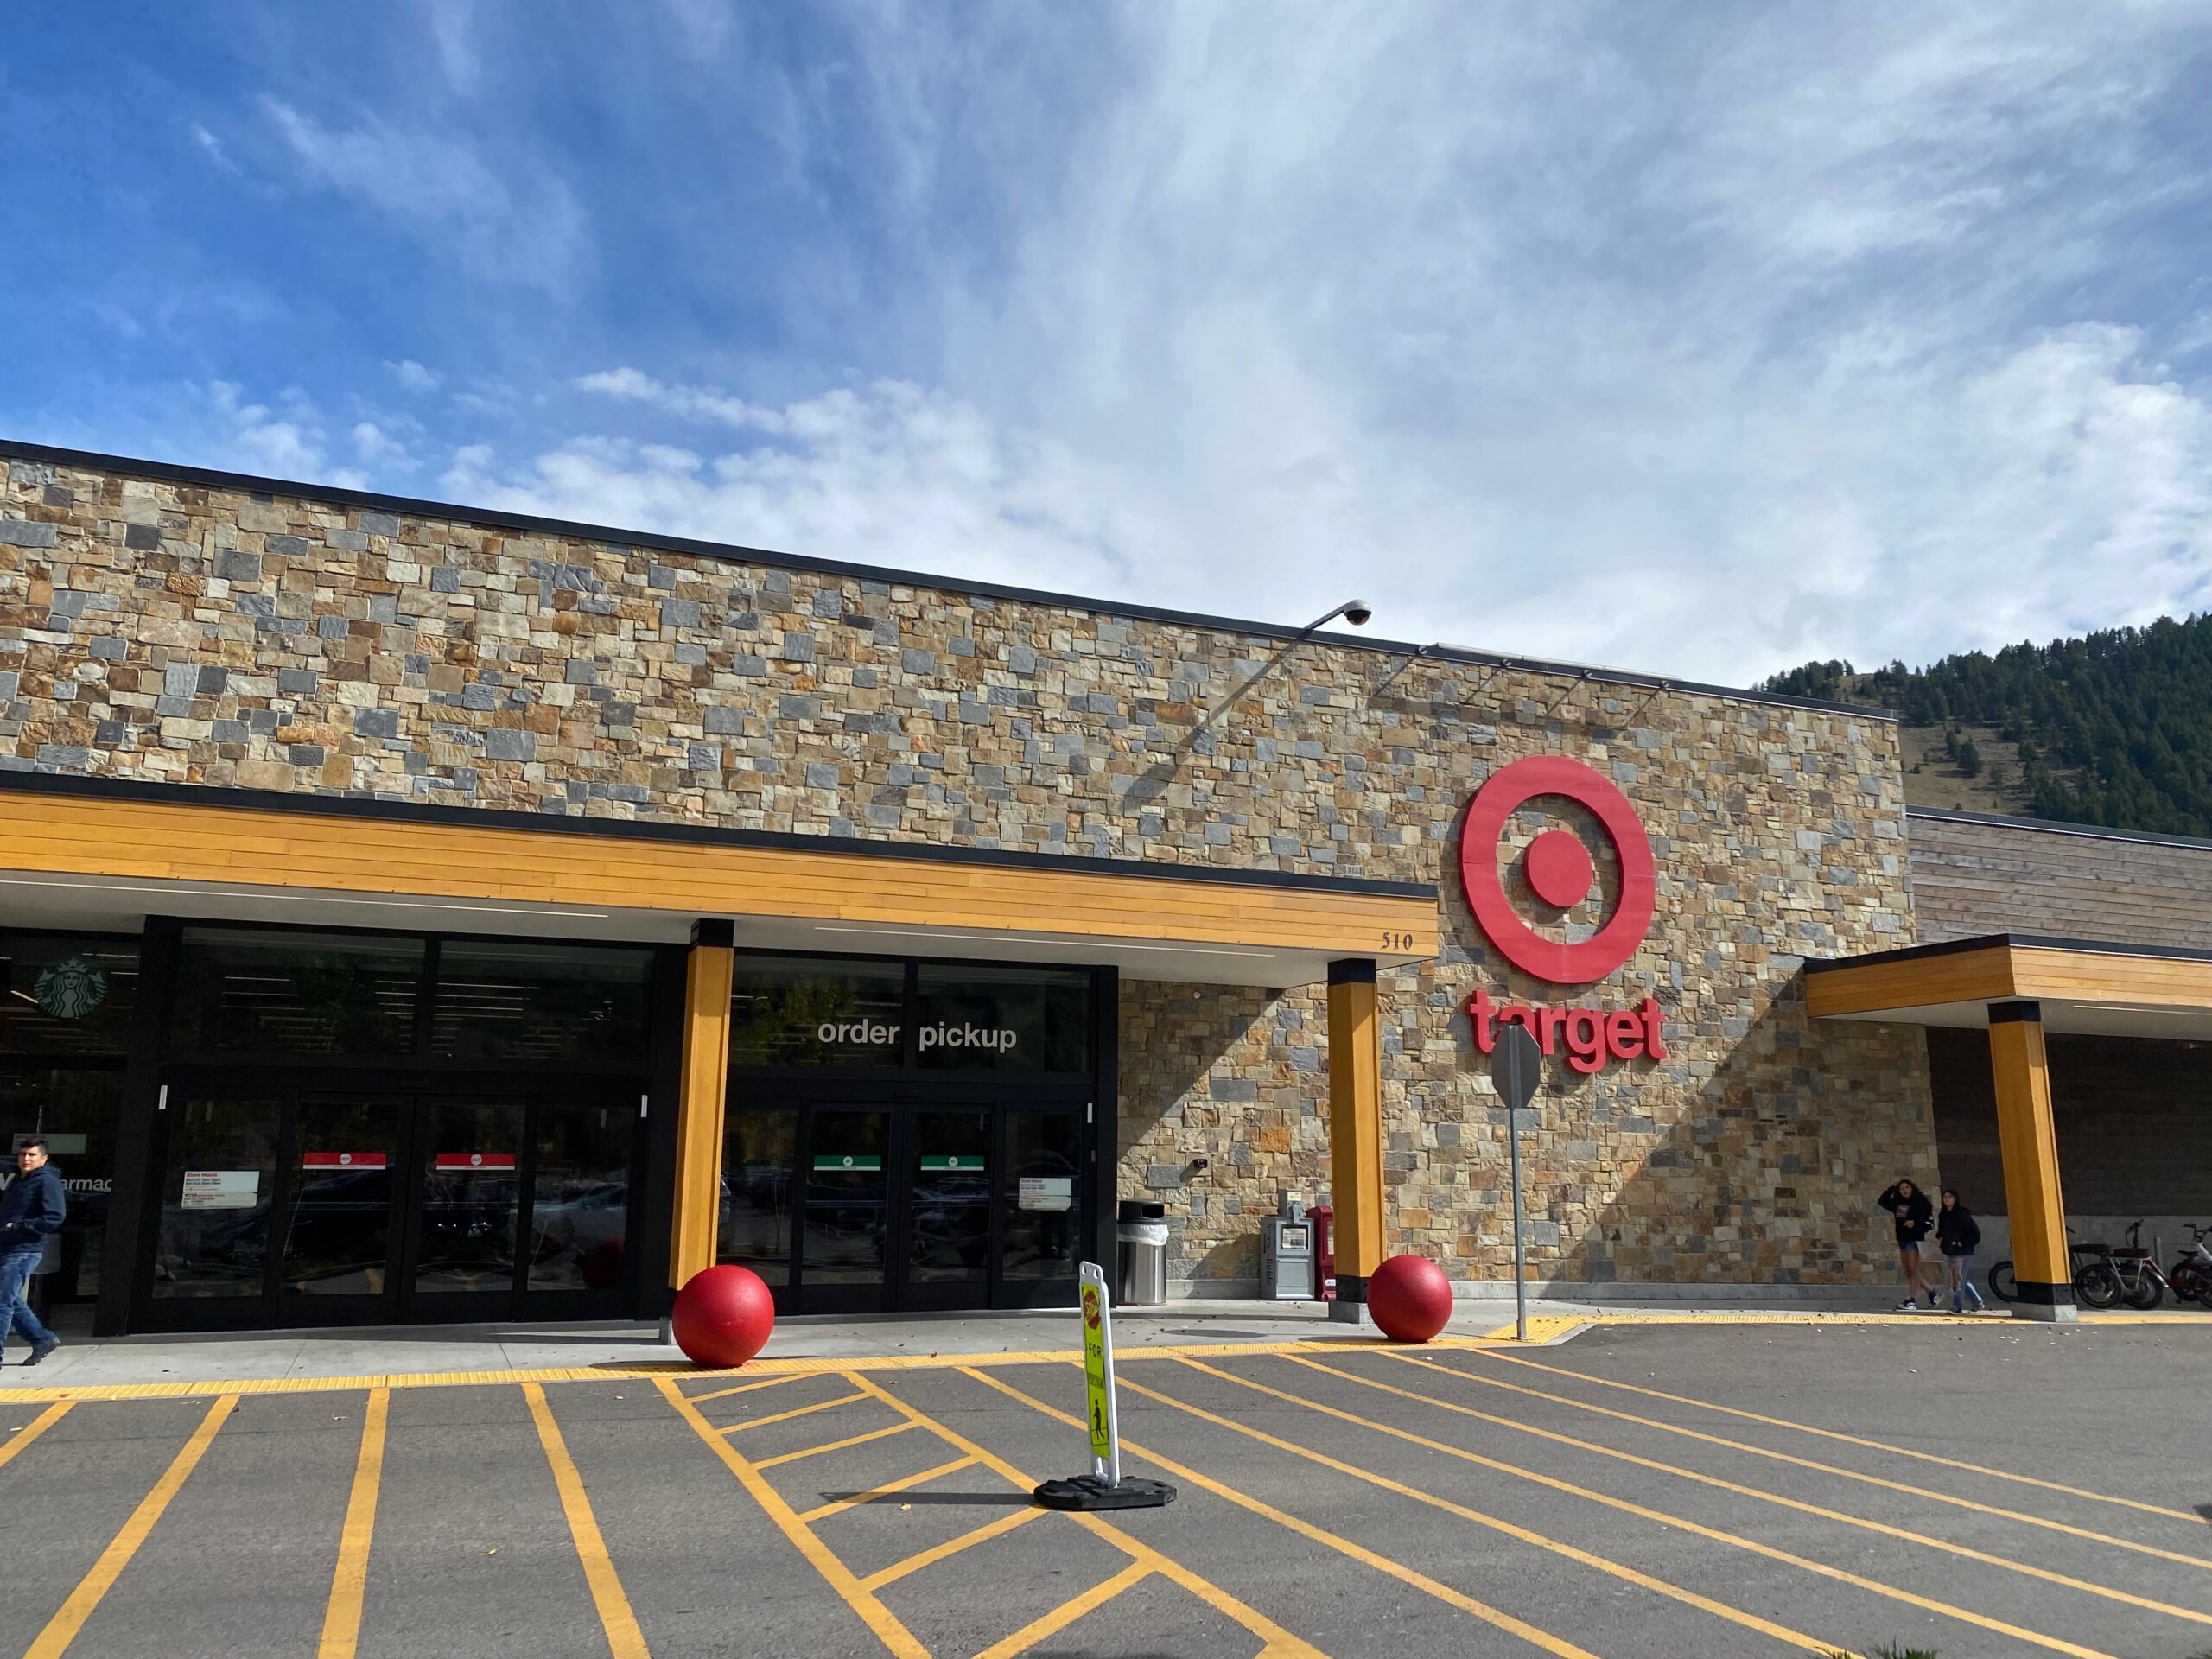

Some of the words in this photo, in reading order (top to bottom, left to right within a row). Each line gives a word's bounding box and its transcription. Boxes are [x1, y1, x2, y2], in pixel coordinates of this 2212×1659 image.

[1381, 931, 1414, 950] 510
[817, 1018, 900, 1045] order
[918, 1021, 1017, 1053] pickup
[1469, 989, 1668, 1074] target
[60, 1178, 113, 1192] armac
[1089, 1342, 1102, 1358] FOR
